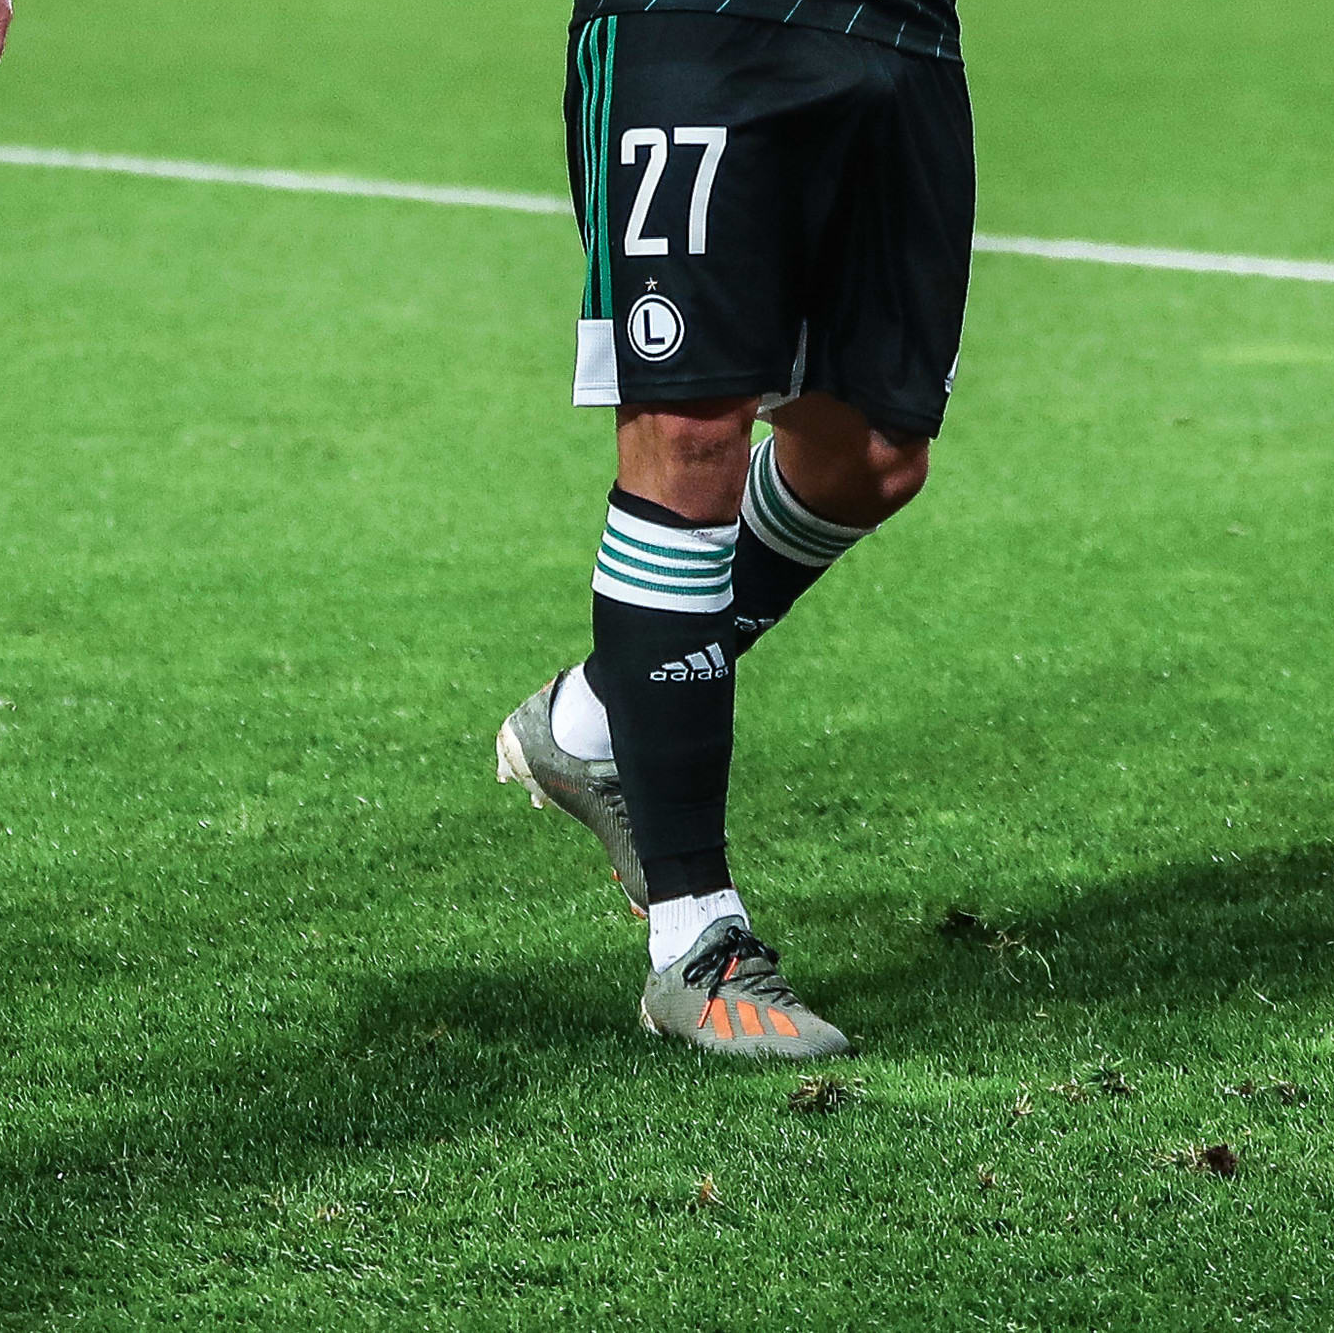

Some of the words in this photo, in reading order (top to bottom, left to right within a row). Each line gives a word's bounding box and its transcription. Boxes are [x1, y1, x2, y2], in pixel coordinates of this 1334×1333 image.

[620, 126, 728, 257] 27
[642, 308, 666, 346] L
[649, 665, 729, 682] adidas
